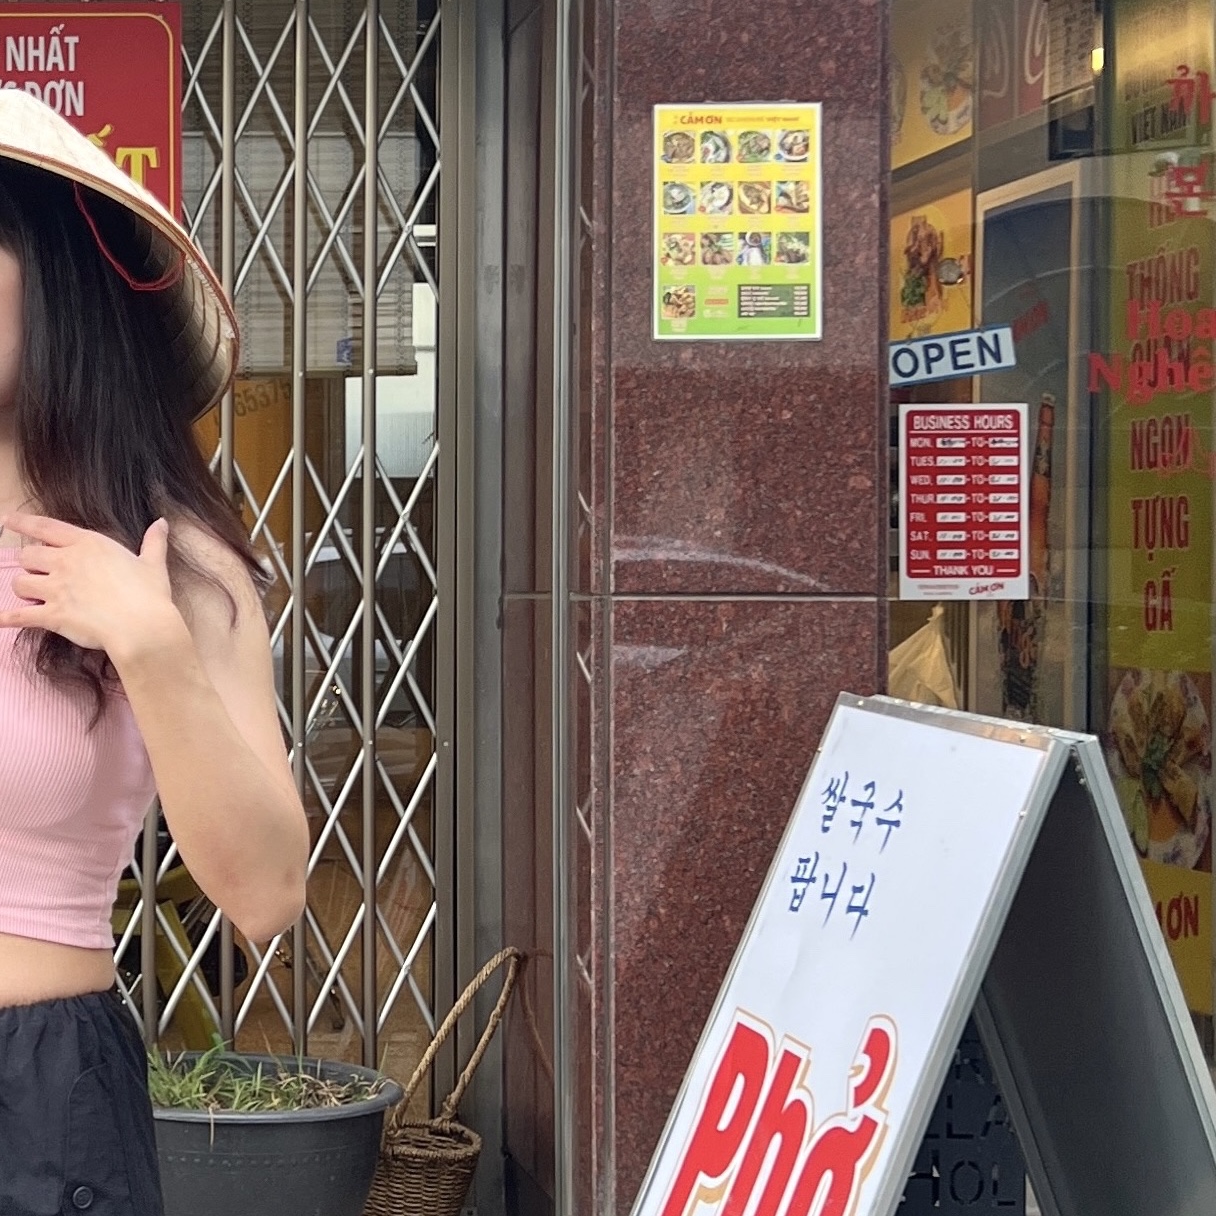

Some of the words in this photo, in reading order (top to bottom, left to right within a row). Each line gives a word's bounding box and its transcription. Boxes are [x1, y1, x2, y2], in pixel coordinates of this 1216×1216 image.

[5, 24, 80, 71] NHẤT
[1126, 299, 1216, 340] Hoa
[892, 333, 993, 379] OPEN
[913, 415, 971, 430] BUSINESS
[973, 415, 1014, 430] HOURS
[933, 565, 970, 576] THANK
[971, 565, 994, 576] YOU
[821, 770, 904, 855] 쌀국수
[789, 851, 876, 941] 팝니다
